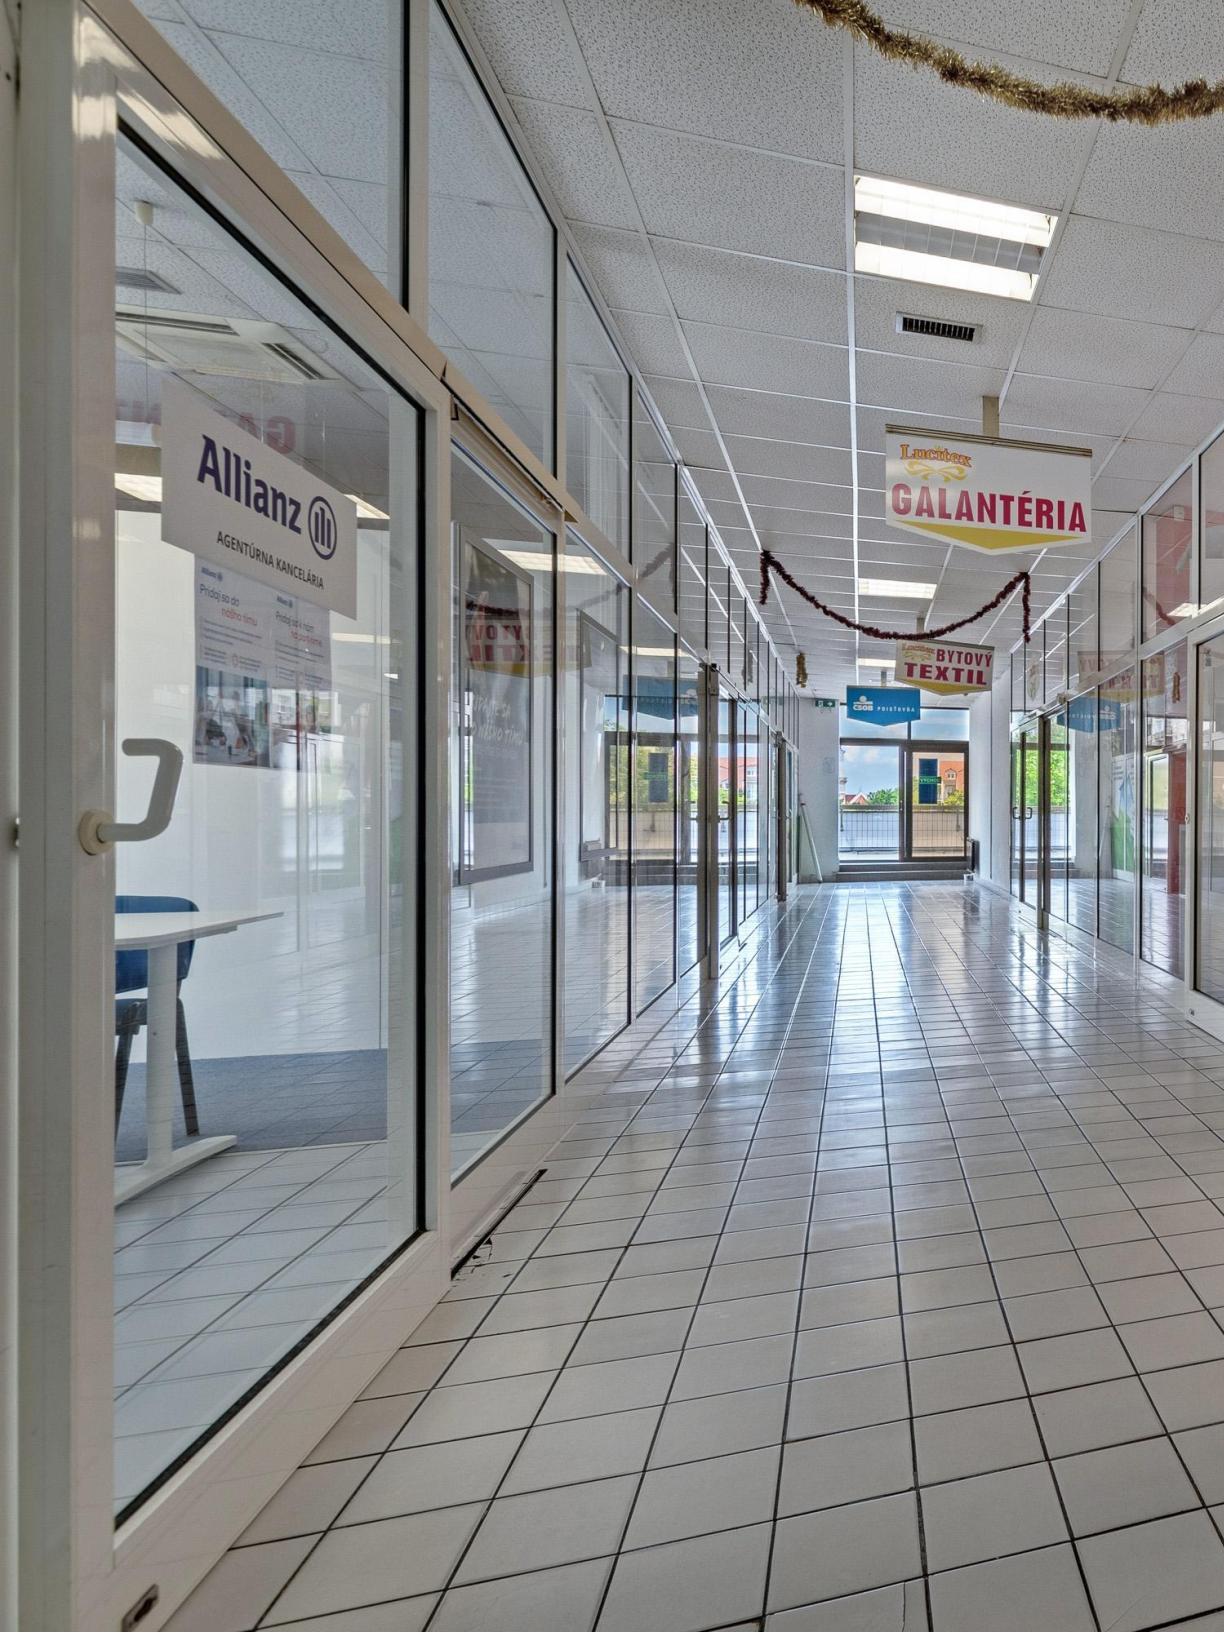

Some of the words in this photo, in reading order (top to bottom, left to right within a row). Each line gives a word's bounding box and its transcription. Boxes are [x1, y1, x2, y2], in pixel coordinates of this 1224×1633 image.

[900, 443, 973, 468] Lucitex
[197, 434, 302, 535] Allianz
[891, 483, 1087, 533] GALANTÉRIA
[216, 531, 275, 568] AGENTÚRNA
[275, 557, 325, 590] KANCELÁRIA
[904, 662, 987, 686] TEXTIL
[936, 648, 993, 668] BYTOVÝ
